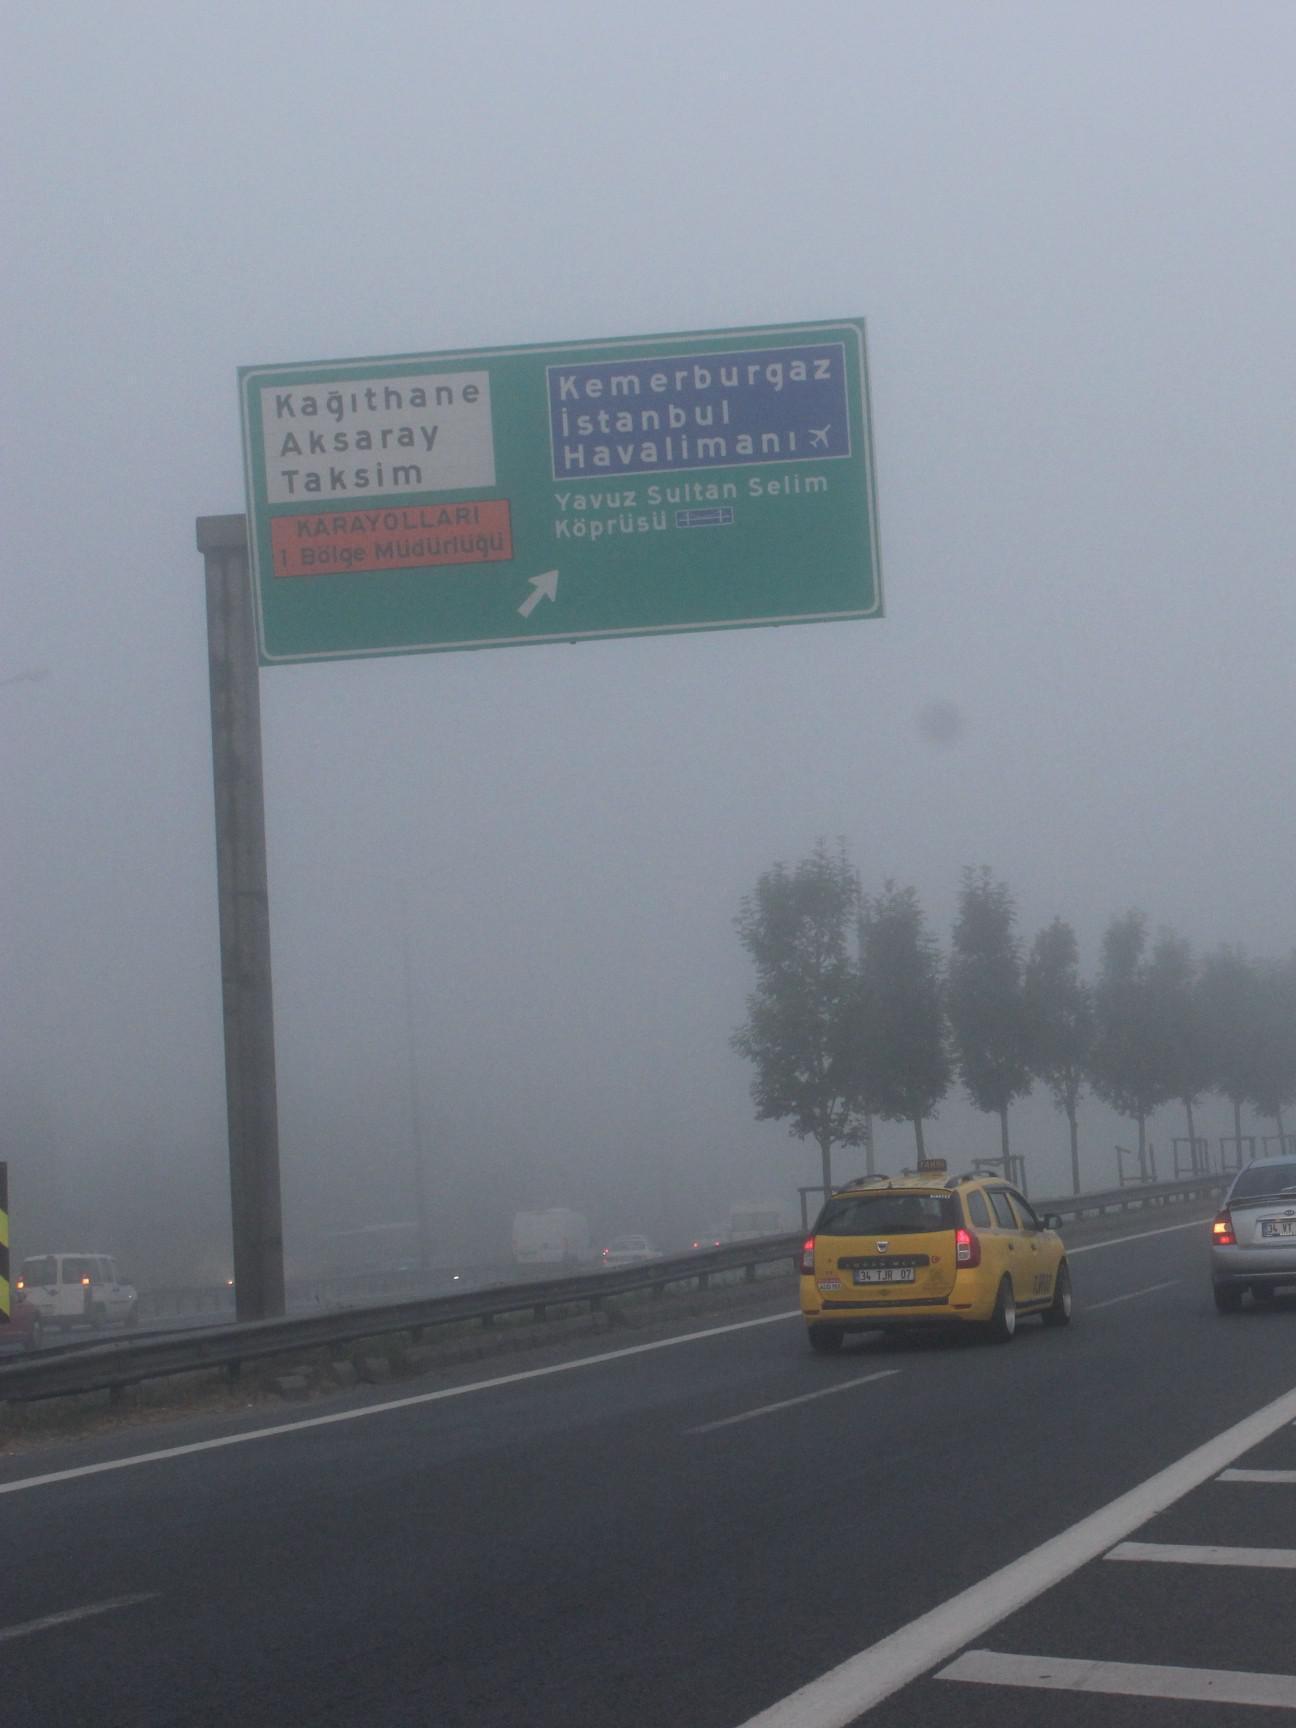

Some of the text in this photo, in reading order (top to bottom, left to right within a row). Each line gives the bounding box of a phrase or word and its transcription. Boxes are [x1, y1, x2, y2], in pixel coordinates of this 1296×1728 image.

[560, 359, 832, 400] Kemerburgaz
[276, 384, 480, 423] Kağıthane
[561, 399, 730, 437] İstanbul
[281, 425, 439, 457] Aksaray
[564, 431, 796, 470] Havalimanı
[281, 462, 423, 494] Taksim
[554, 474, 828, 512] Yavuz Sultan Selim
[296, 505, 481, 537] KARAYOLLARI
[555, 511, 667, 541] Köprüsü
[300, 544, 368, 568] Bölge
[374, 531, 505, 561] Müdürlüğü
[860, 1270, 871, 1281] 34
[901, 1269, 912, 1280] 07
